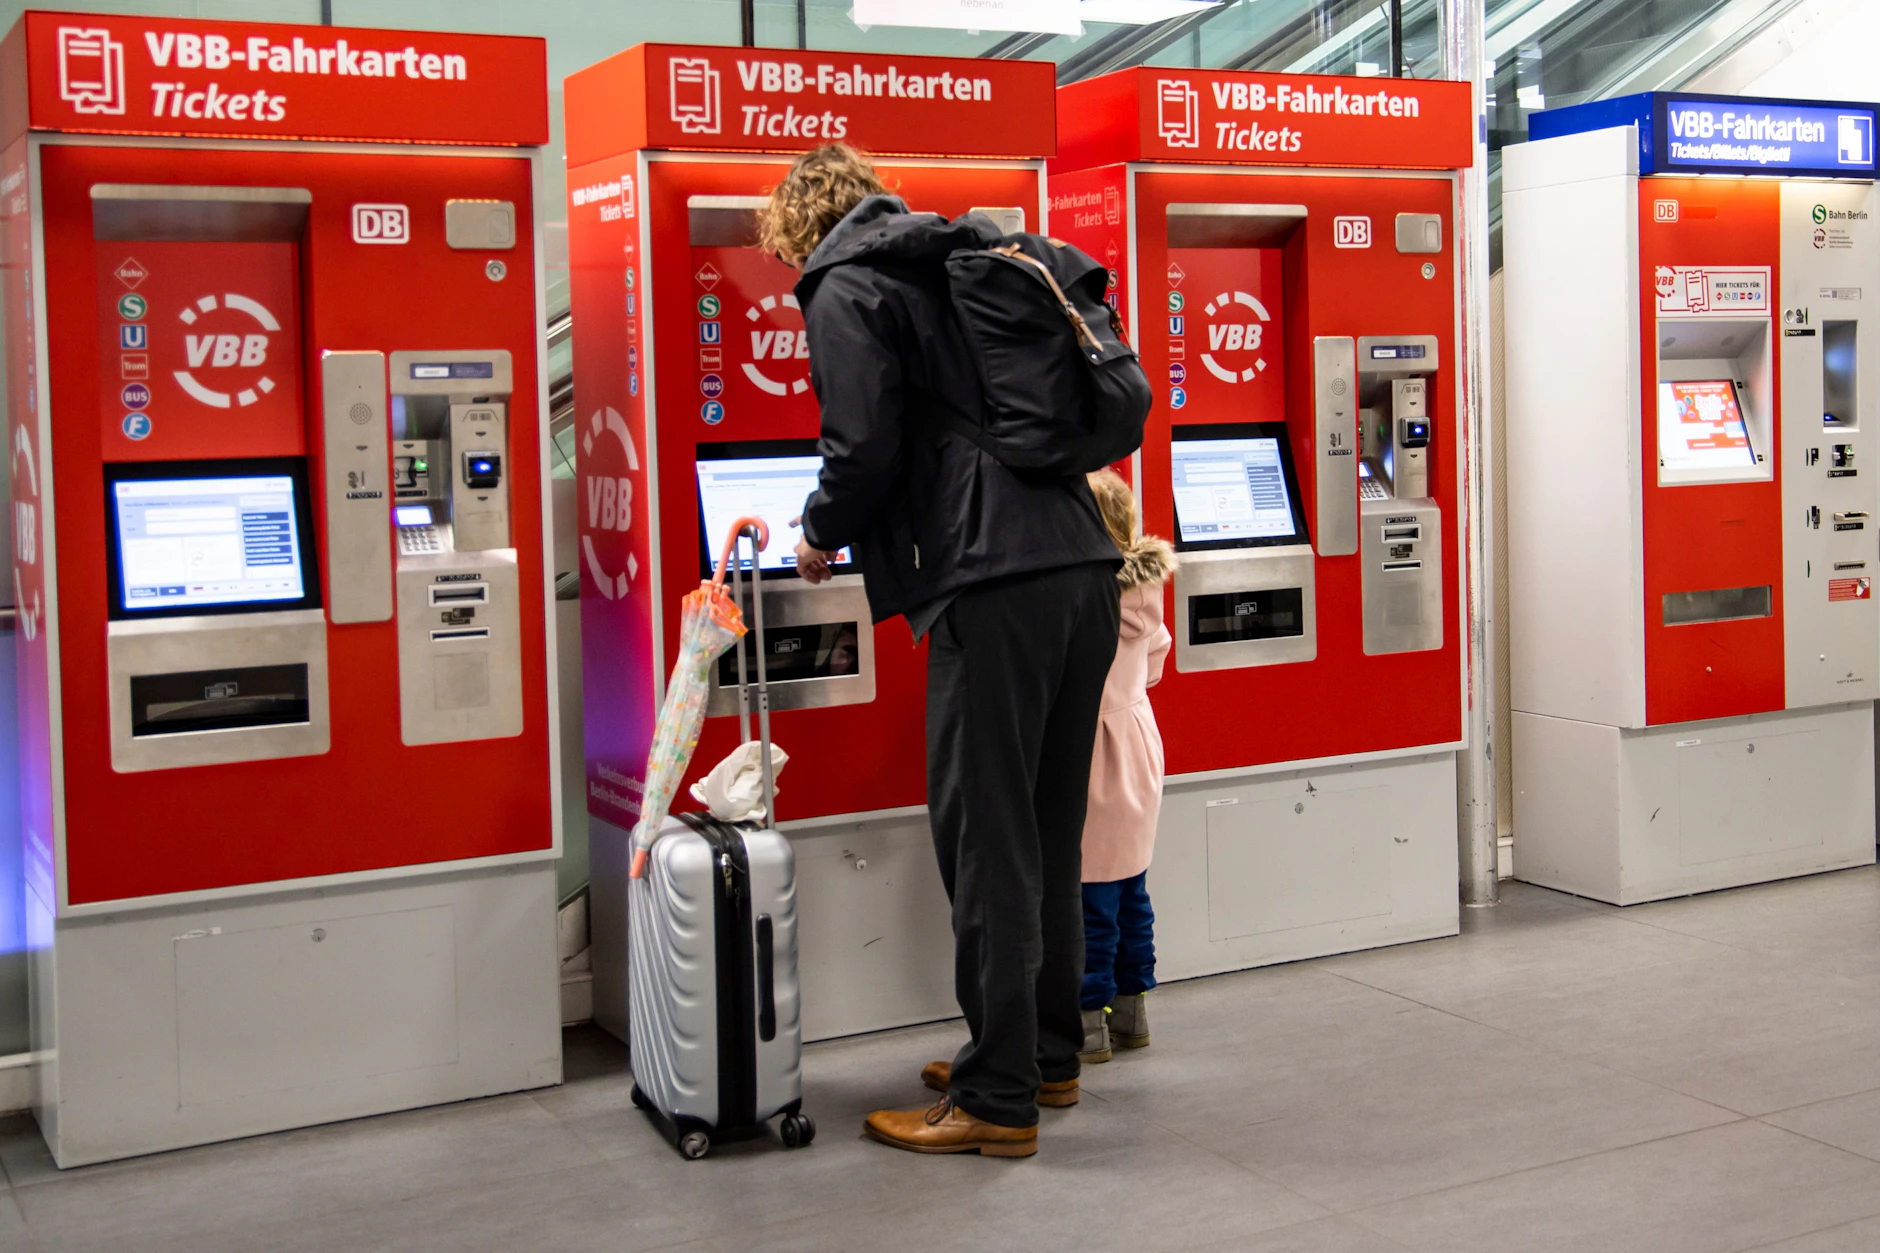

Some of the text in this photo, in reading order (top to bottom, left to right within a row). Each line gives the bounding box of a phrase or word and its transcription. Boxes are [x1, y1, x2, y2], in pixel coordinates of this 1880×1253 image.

[144, 31, 467, 81] VBB-Fahrkarten
[737, 60, 992, 102] VBB-Fahrkarten
[150, 82, 287, 122] Tickets
[1211, 81, 1420, 118] VBB-Fahrkarten
[740, 104, 848, 139] Tickets
[1670, 110, 1825, 143] VBB-Fahrkarten
[1215, 121, 1302, 152] Tickets
[572, 181, 622, 207] VBB-Fahrkarten
[600, 204, 622, 223] Tickets
[1074, 213, 1102, 228] Tickets
[1658, 204, 1675, 218] DB
[1829, 210, 1847, 220] Bahn
[1847, 210, 1868, 220] Berlin
[359, 210, 402, 239] DB
[1338, 221, 1367, 243] DB
[120, 269, 143, 278] Bahn
[699, 272, 718, 281] Bahn
[1656, 276, 1675, 286] VBB
[123, 296, 142, 318] S
[701, 297, 717, 316] S
[1169, 293, 1181, 311] S
[703, 323, 717, 343] U
[1169, 317, 1182, 334] U
[125, 327, 142, 347] U
[1208, 324, 1263, 351] VBB
[185, 334, 269, 368] VBB
[702, 354, 720, 362] Tram
[123, 361, 146, 370] Tram
[1170, 370, 1184, 378] BUS
[703, 381, 722, 391] BUS
[125, 392, 147, 402] BUS
[705, 403, 718, 420] F
[128, 417, 143, 435] F
[587, 475, 633, 532] VBB
